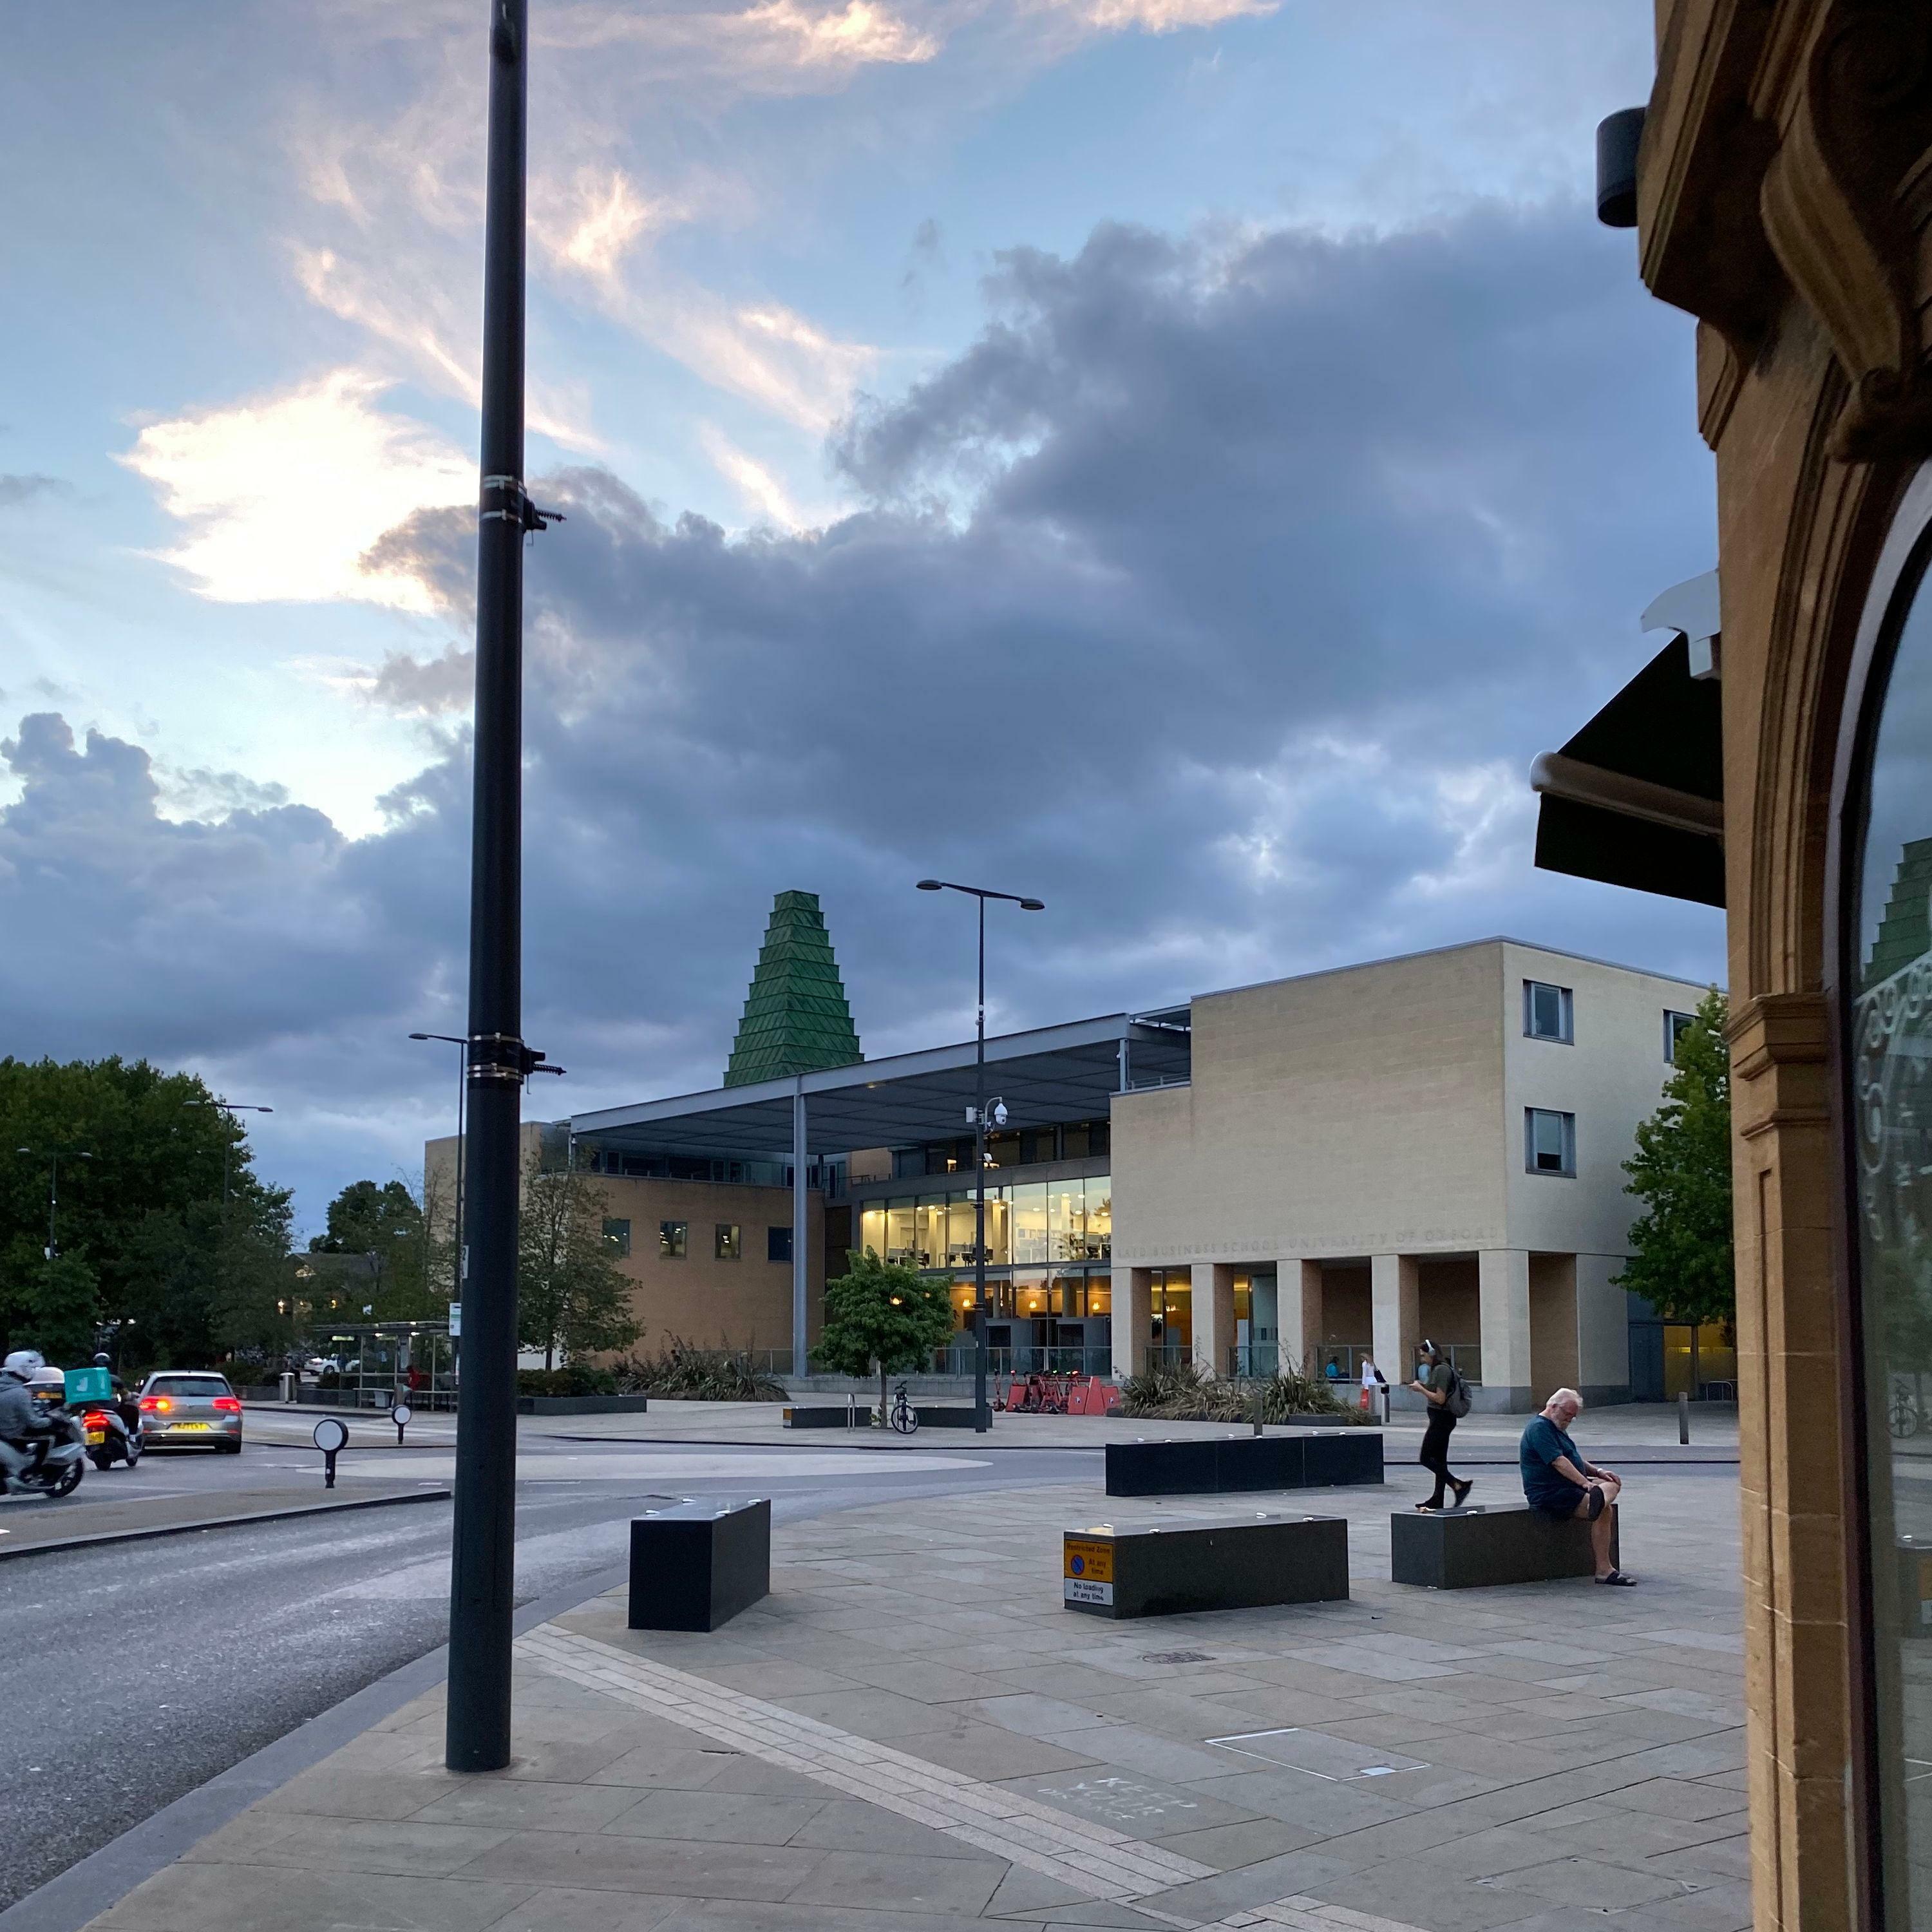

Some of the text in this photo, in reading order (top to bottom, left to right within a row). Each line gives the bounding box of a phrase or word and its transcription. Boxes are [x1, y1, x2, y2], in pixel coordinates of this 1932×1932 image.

[1153, 1243, 1216, 1256] BUSINESS
[1223, 1239, 1279, 1252] SCHOOL
[1396, 1229, 1416, 1242] OF
[1066, 1543, 1095, 1552] Restricted
[1083, 1584, 1103, 1594] loading
[1092, 1592, 1104, 1600] time
[1068, 1782, 1164, 1816] YOUR
[1094, 1777, 1198, 1808] KEEP
